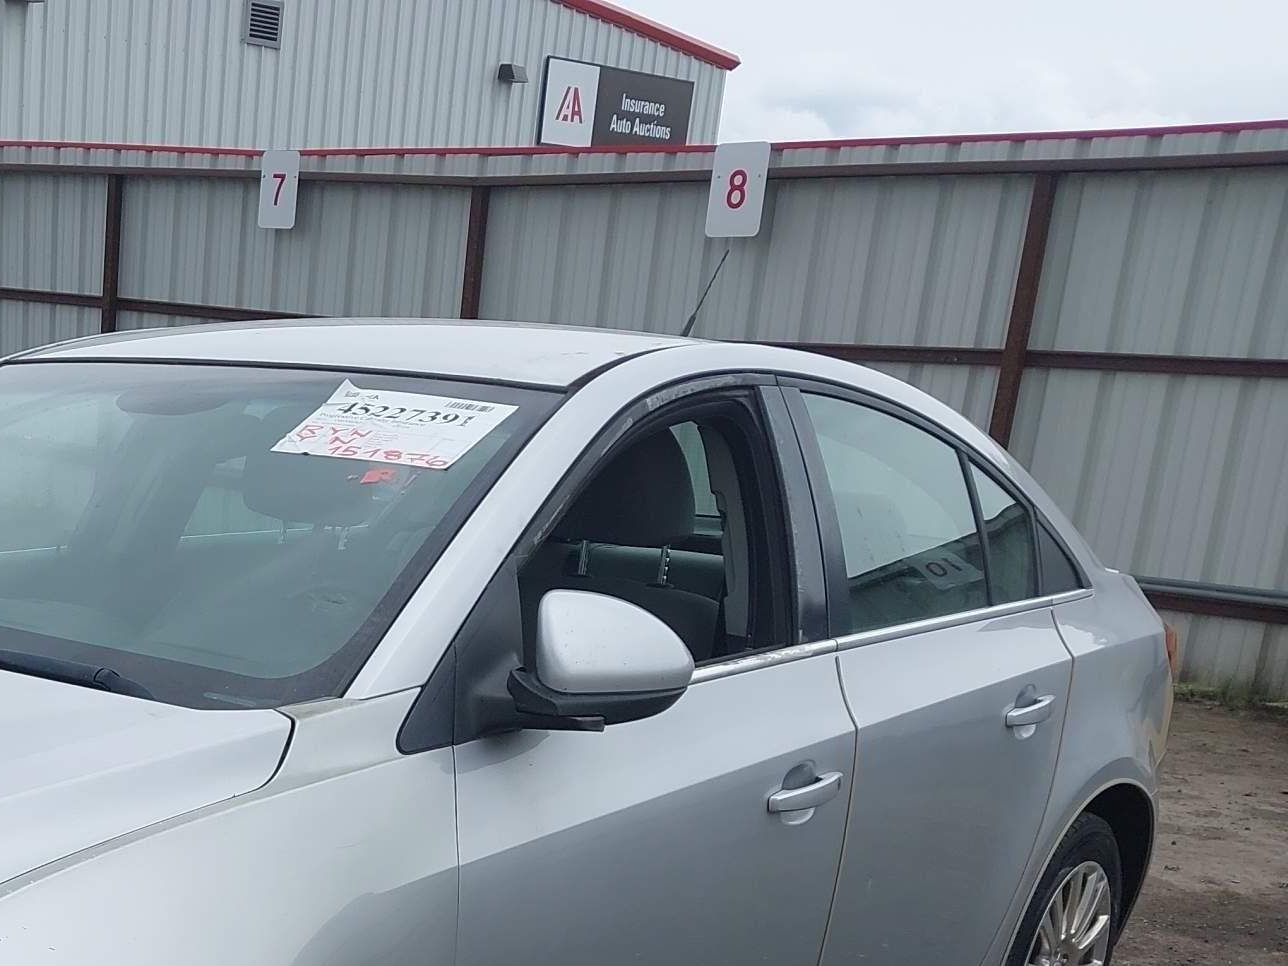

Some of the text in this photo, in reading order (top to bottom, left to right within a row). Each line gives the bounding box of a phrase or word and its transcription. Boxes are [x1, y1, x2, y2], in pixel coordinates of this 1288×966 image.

[621, 93, 665, 117] Insurance
[610, 114, 671, 140] Auto Auctions
[272, 173, 286, 206] 7
[726, 169, 748, 209] 8
[336, 401, 476, 428] 45227391
